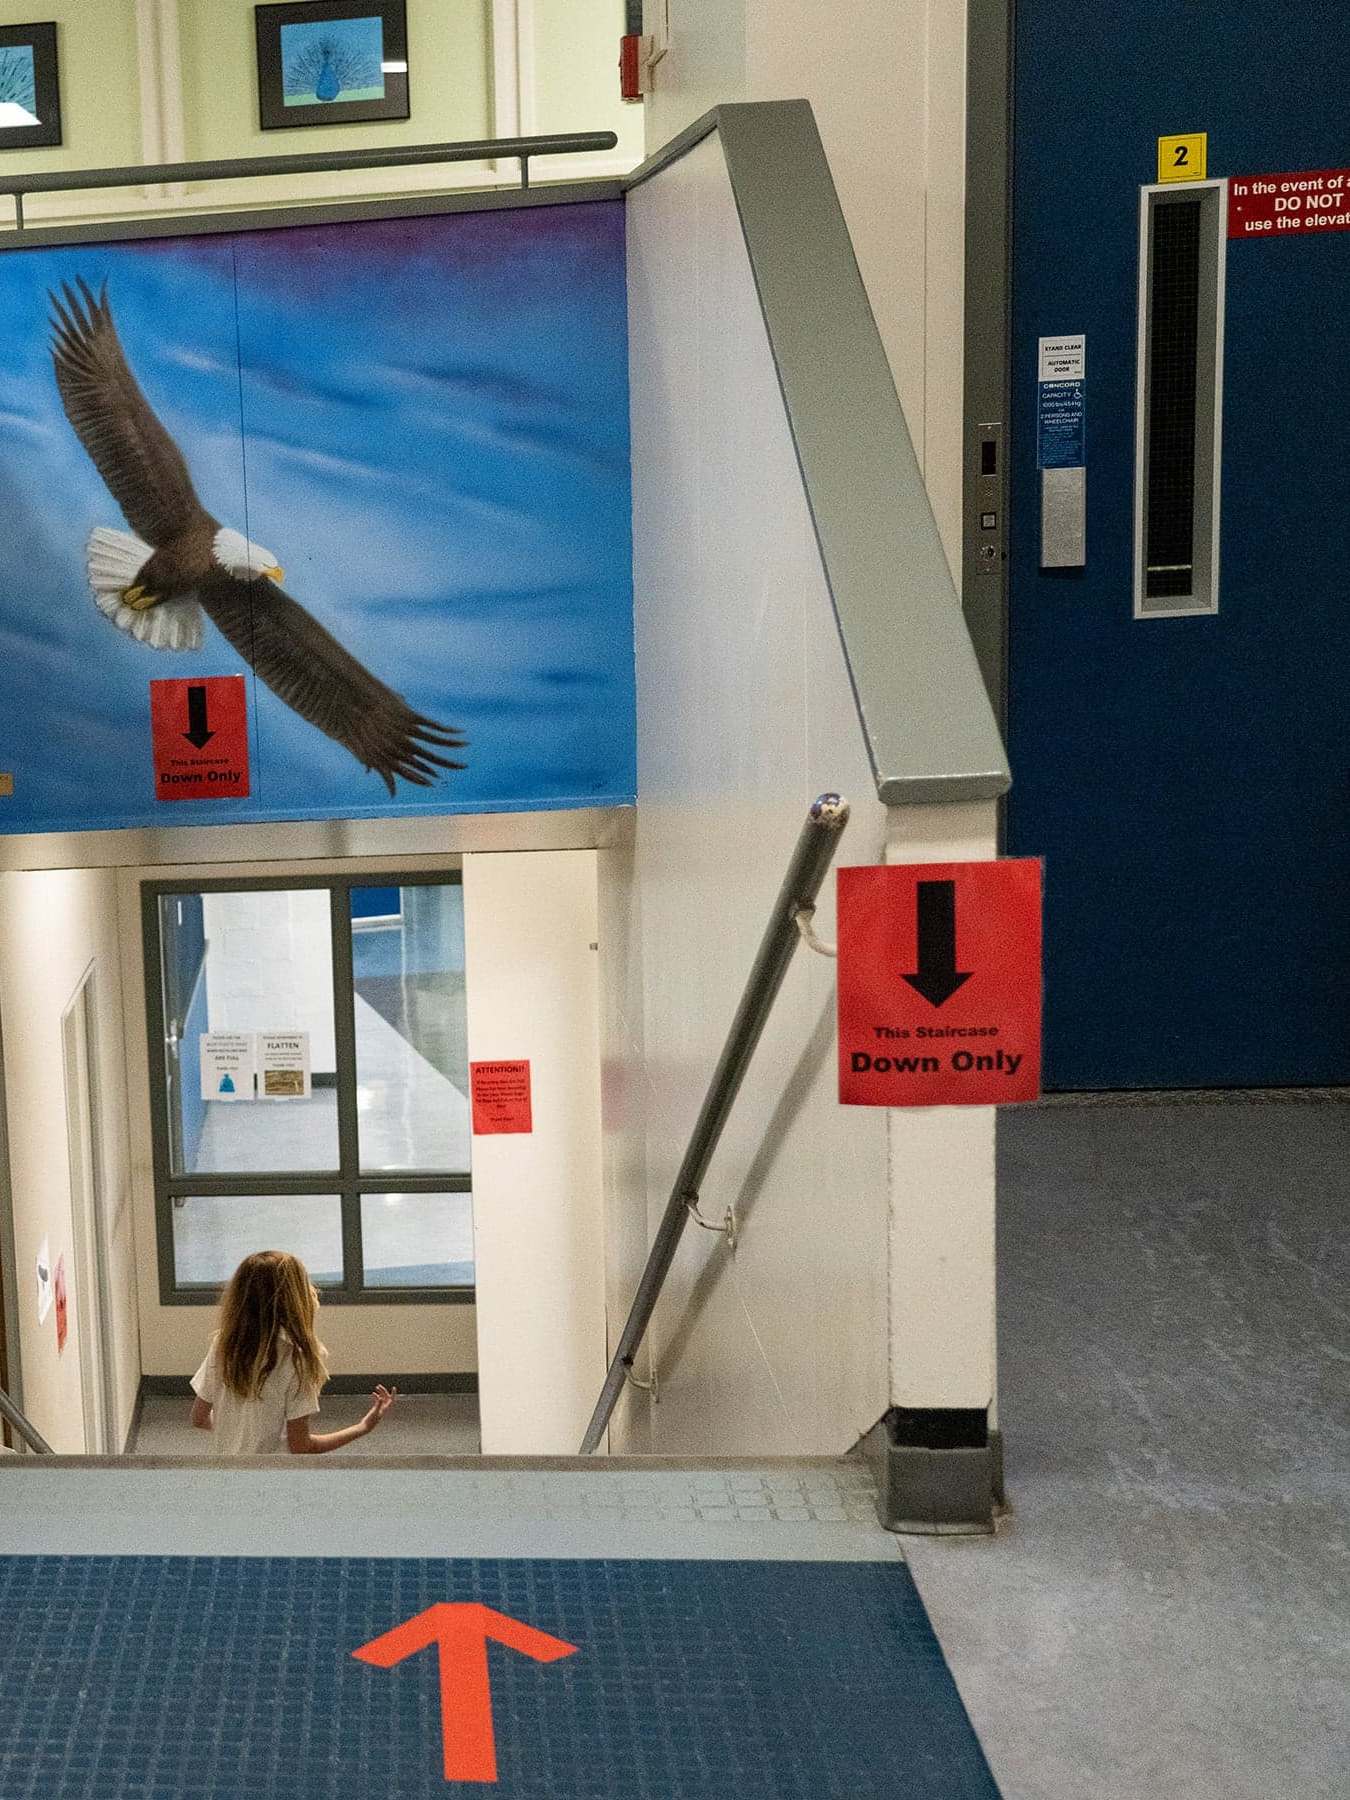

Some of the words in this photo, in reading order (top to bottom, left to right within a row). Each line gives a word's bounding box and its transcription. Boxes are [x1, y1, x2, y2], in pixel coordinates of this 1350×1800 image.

[1173, 145, 1189, 166] 2
[1234, 183, 1248, 196] In
[1252, 180, 1277, 195] the
[1280, 177, 1323, 192] event
[1327, 175, 1344, 189] of
[1274, 196, 1300, 212] DO
[1306, 193, 1344, 209] NOT
[1245, 220, 1272, 232] use
[1276, 216, 1300, 229] the
[190, 758, 229, 766] Staircase
[160, 772, 203, 784] Down
[207, 770, 241, 783] Only
[873, 1026, 910, 1039] This
[916, 1025, 999, 1039] Staircase
[476, 1066, 524, 1074] ATTENTION!!
[851, 1051, 939, 1073] Down
[951, 1049, 1022, 1075] Only
